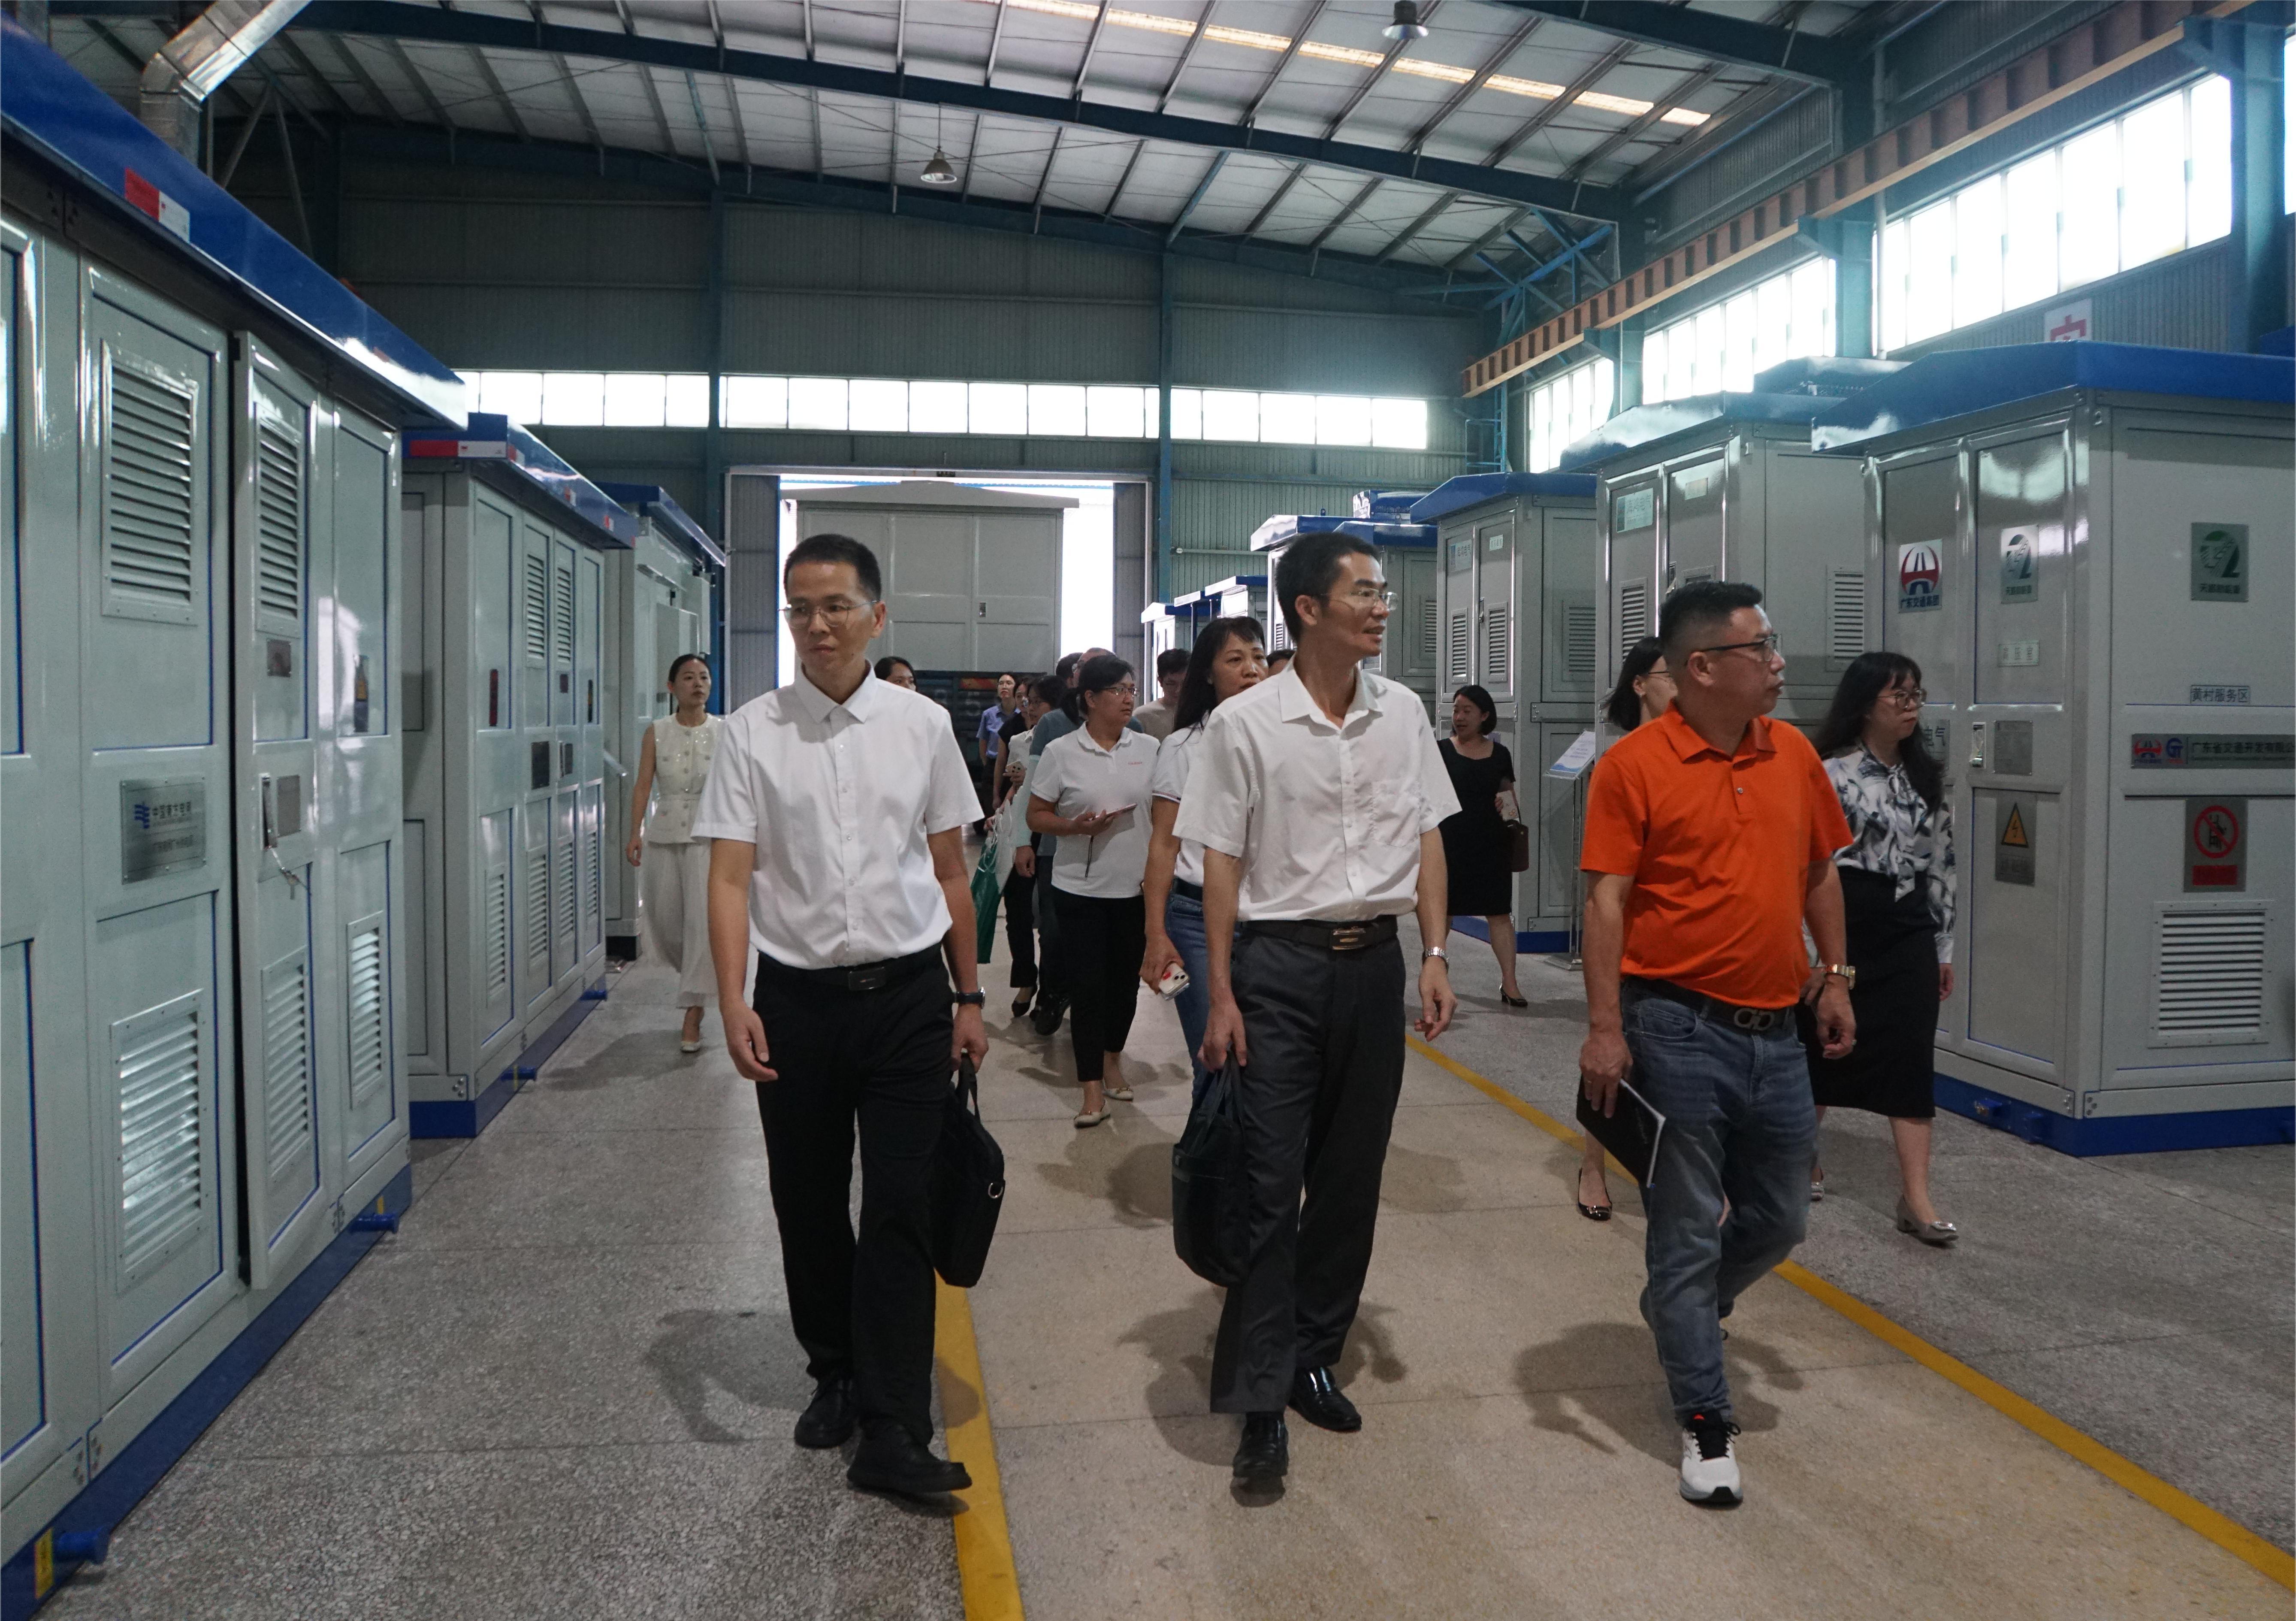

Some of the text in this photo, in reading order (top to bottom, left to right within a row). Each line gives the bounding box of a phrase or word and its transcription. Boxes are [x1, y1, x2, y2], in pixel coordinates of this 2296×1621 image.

[1900, 595, 1940, 608] 广东交通集团
[2191, 687, 2248, 703] 黄村服务区
